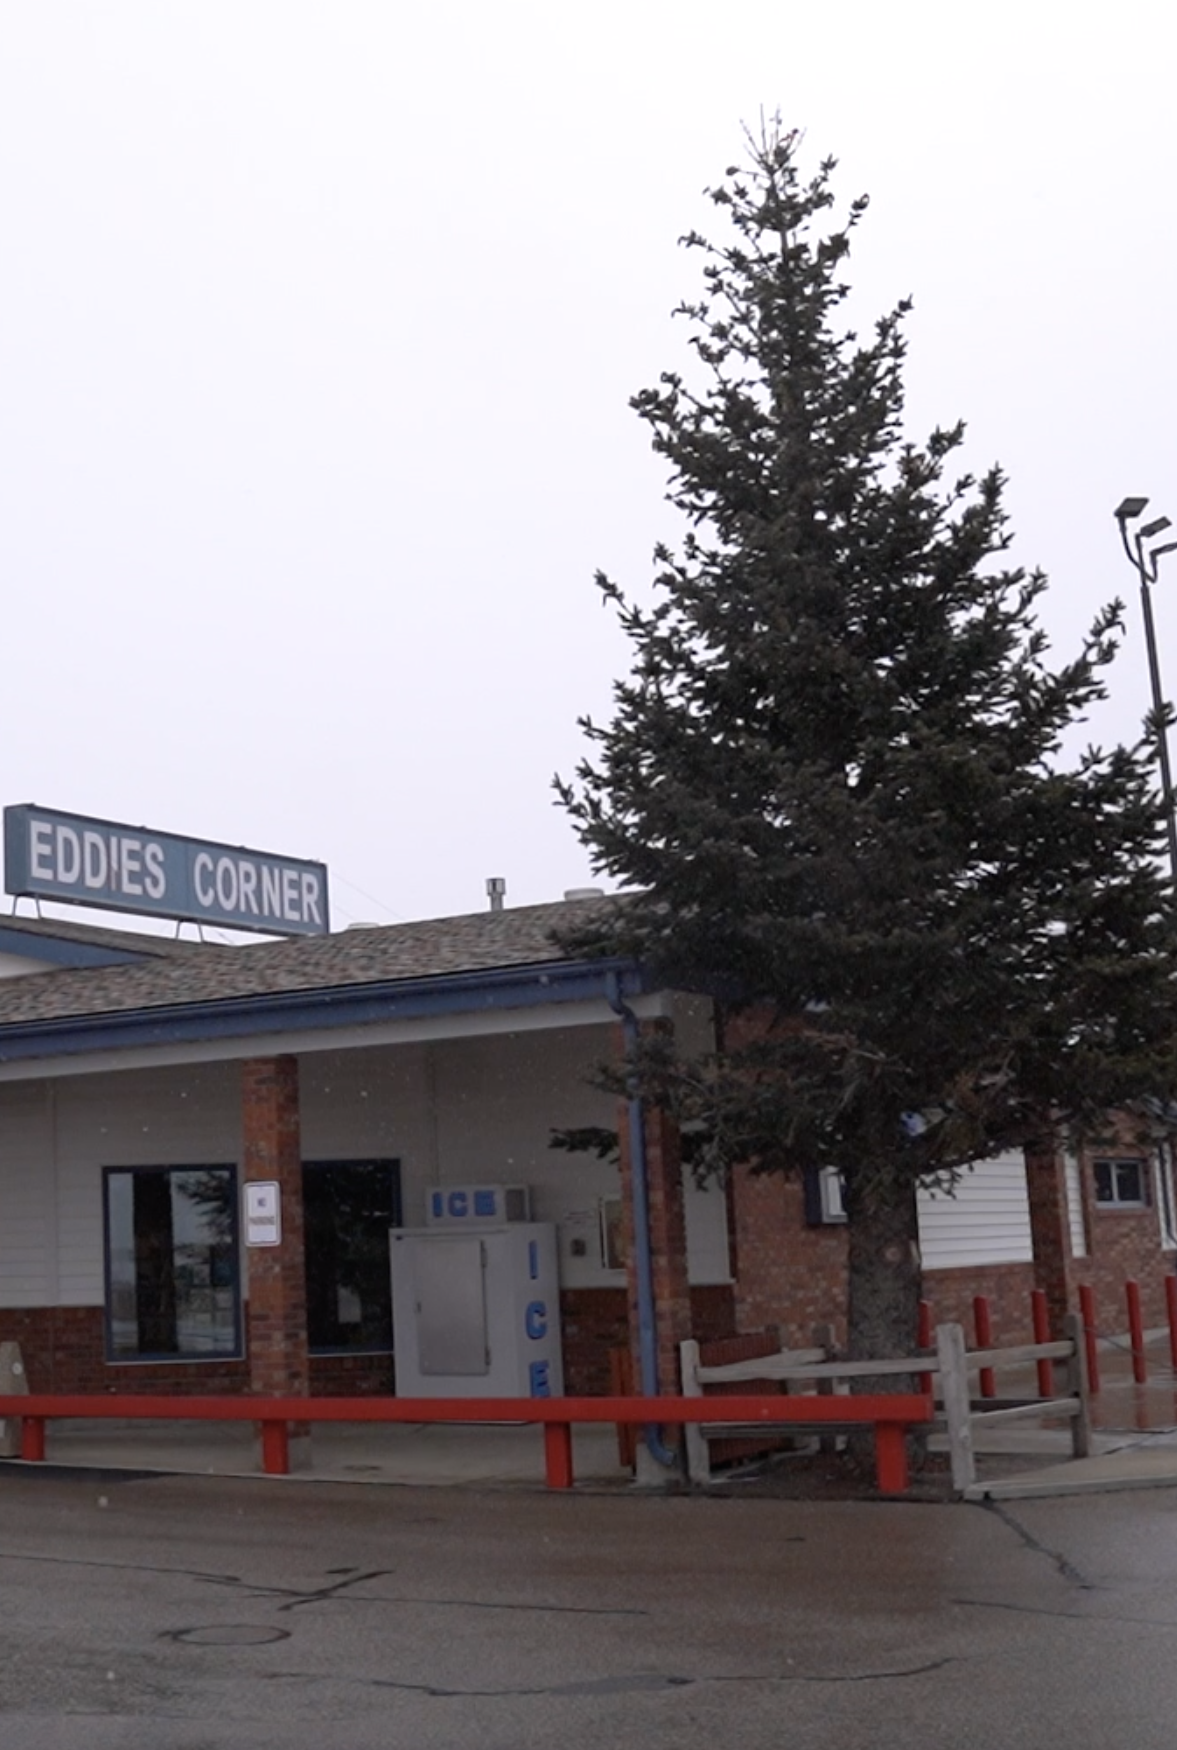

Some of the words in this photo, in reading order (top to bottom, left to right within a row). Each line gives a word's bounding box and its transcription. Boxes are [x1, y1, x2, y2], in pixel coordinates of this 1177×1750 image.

[30, 819, 166, 899] EDDIES
[193, 852, 322, 924] CORNER
[431, 1190, 497, 1218] ICE
[525, 1240, 550, 1398] ICE
